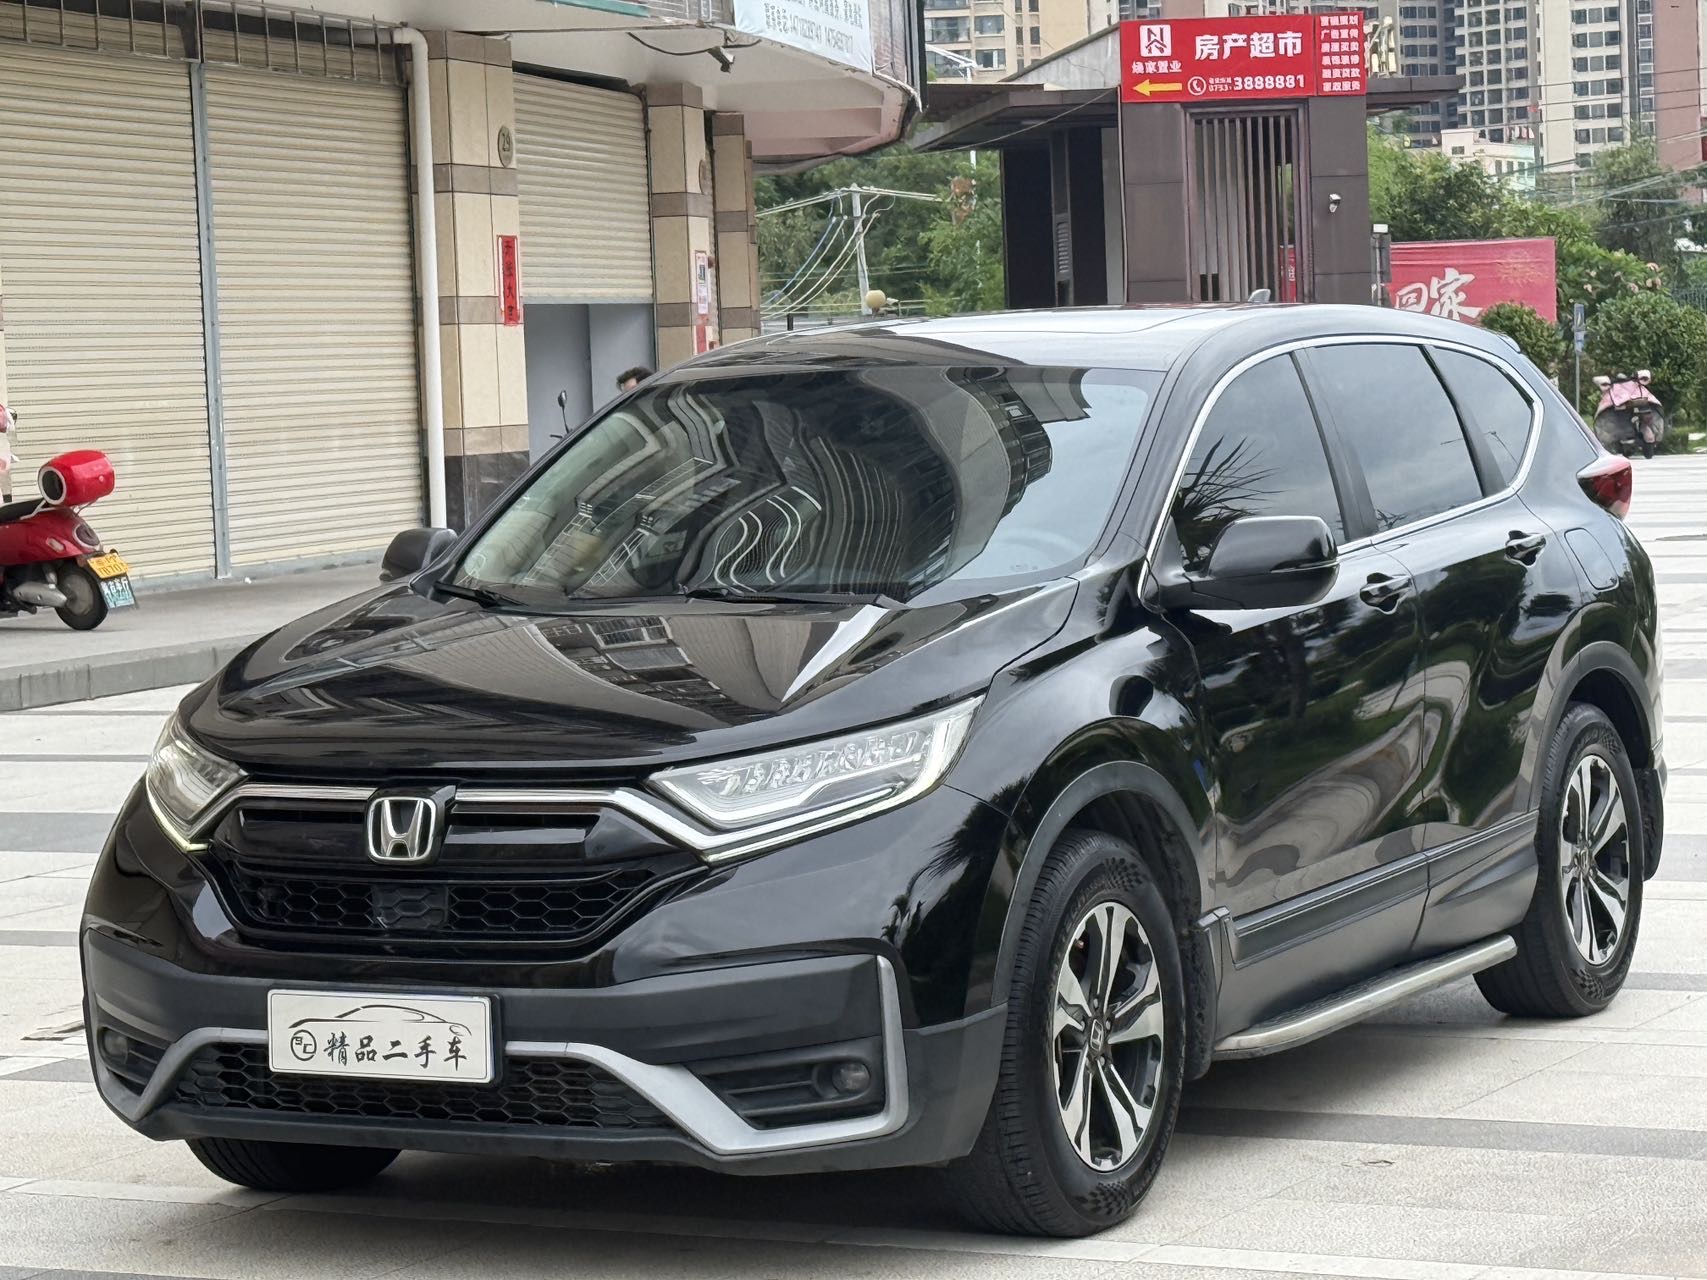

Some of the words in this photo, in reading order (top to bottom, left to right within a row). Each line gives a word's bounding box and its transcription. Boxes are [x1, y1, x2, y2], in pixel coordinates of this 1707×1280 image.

[1194, 31, 1303, 61] 房产超市
[1233, 74, 1305, 91] 3888881
[1394, 267, 1483, 321] 回家
[323, 1031, 467, 1071] 精品二手车
